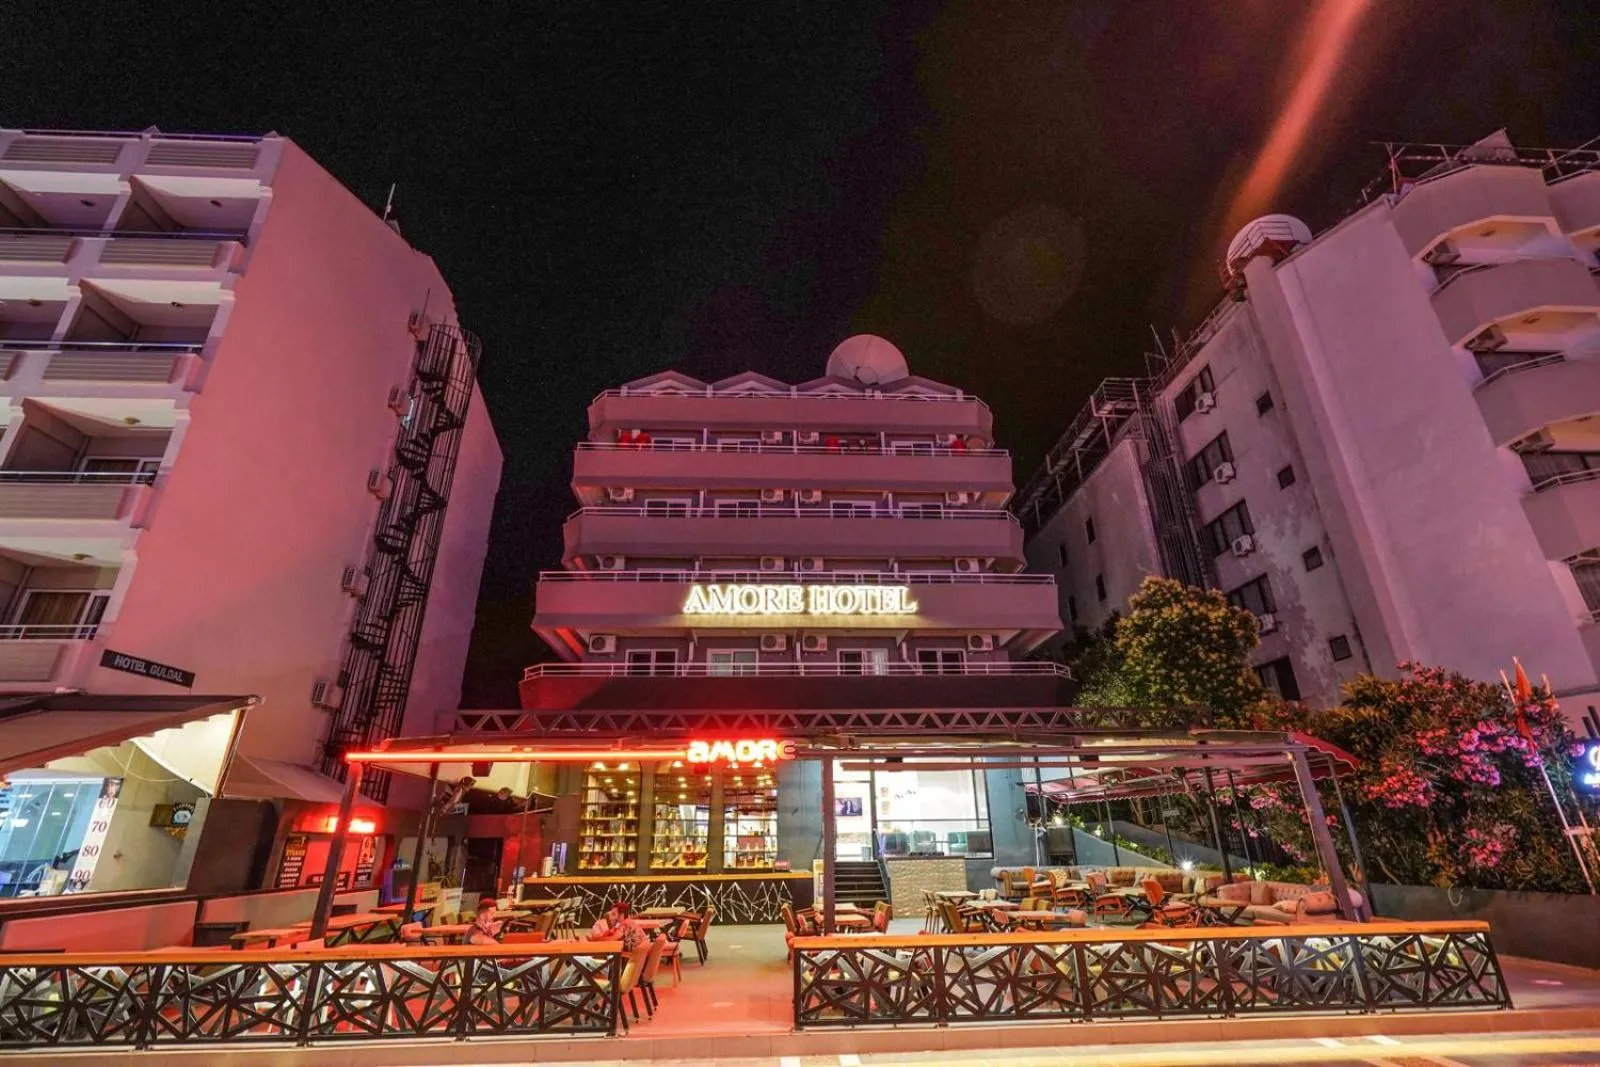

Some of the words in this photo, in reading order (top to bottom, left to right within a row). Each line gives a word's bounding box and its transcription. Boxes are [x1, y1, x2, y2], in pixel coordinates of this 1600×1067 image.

[683, 584, 804, 614] AMORE
[808, 585, 917, 614] HOTEL
[114, 655, 147, 673] HOTEL
[91, 821, 107, 833] 70
[82, 845, 99, 857] 80
